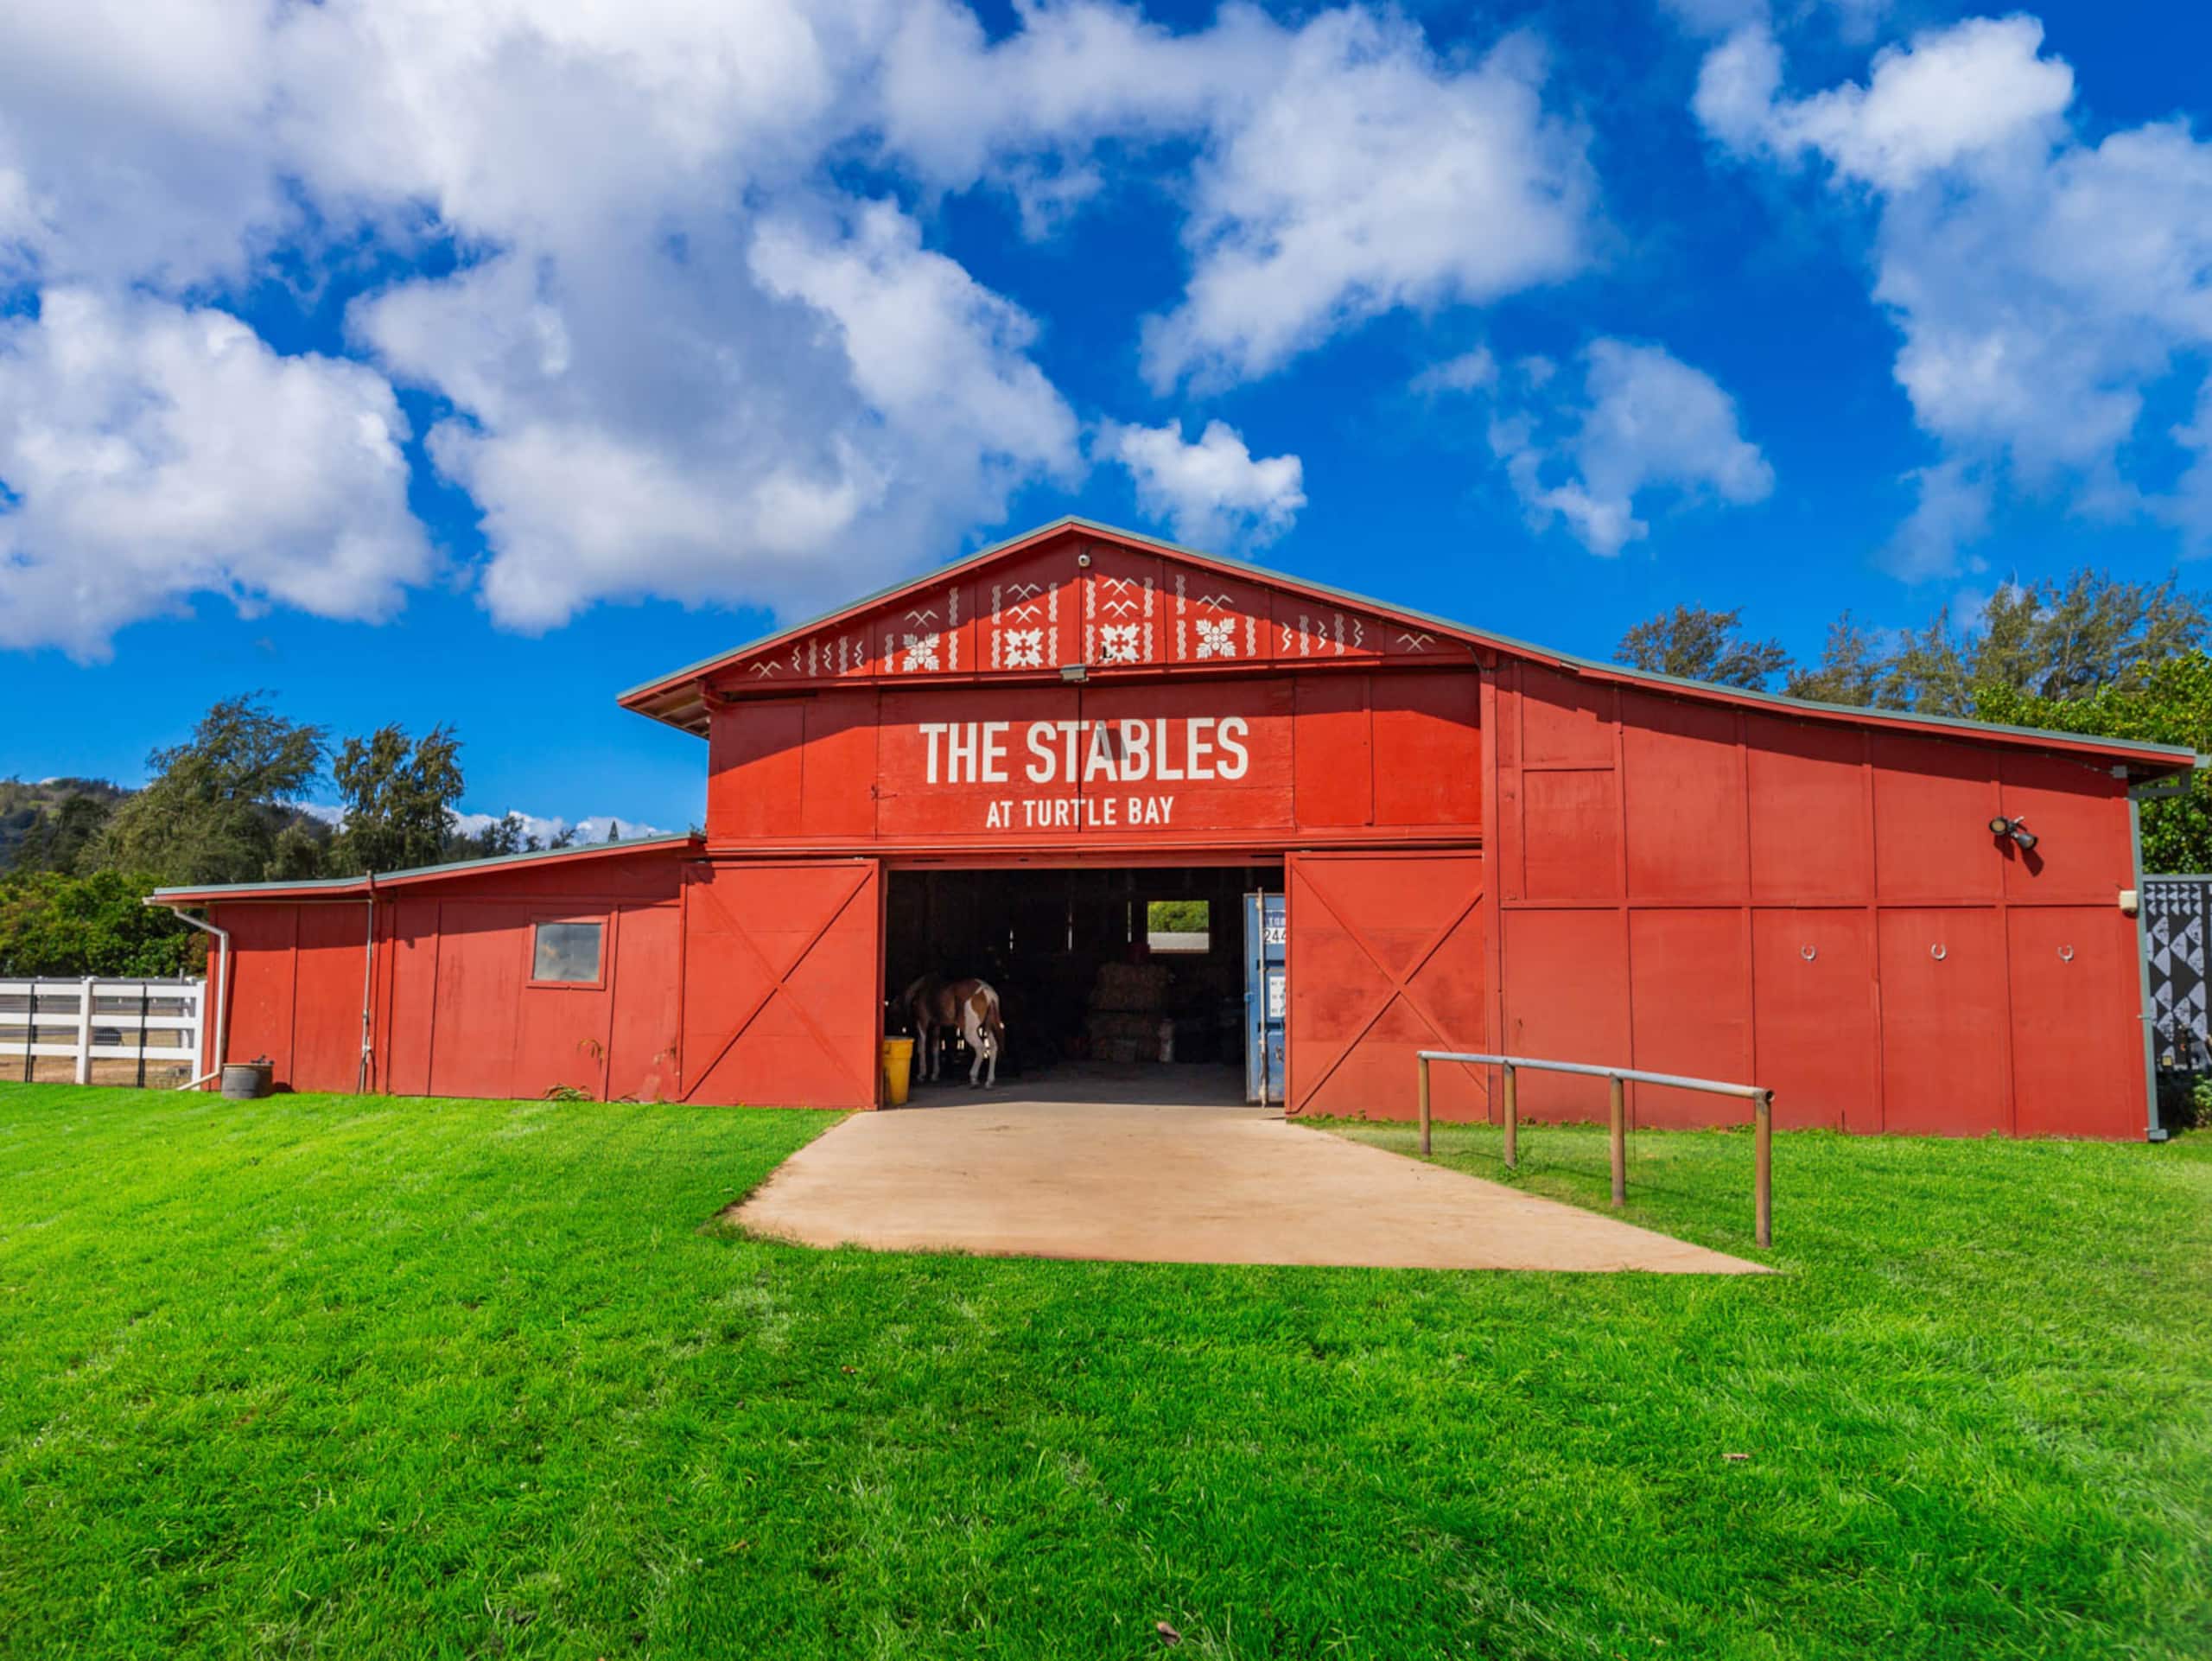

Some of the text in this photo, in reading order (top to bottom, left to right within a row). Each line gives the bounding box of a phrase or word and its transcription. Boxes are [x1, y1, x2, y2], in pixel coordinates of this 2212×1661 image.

[918, 716, 1249, 784] THE STABLES
[986, 796, 1175, 829] AT TURTLE BAY
